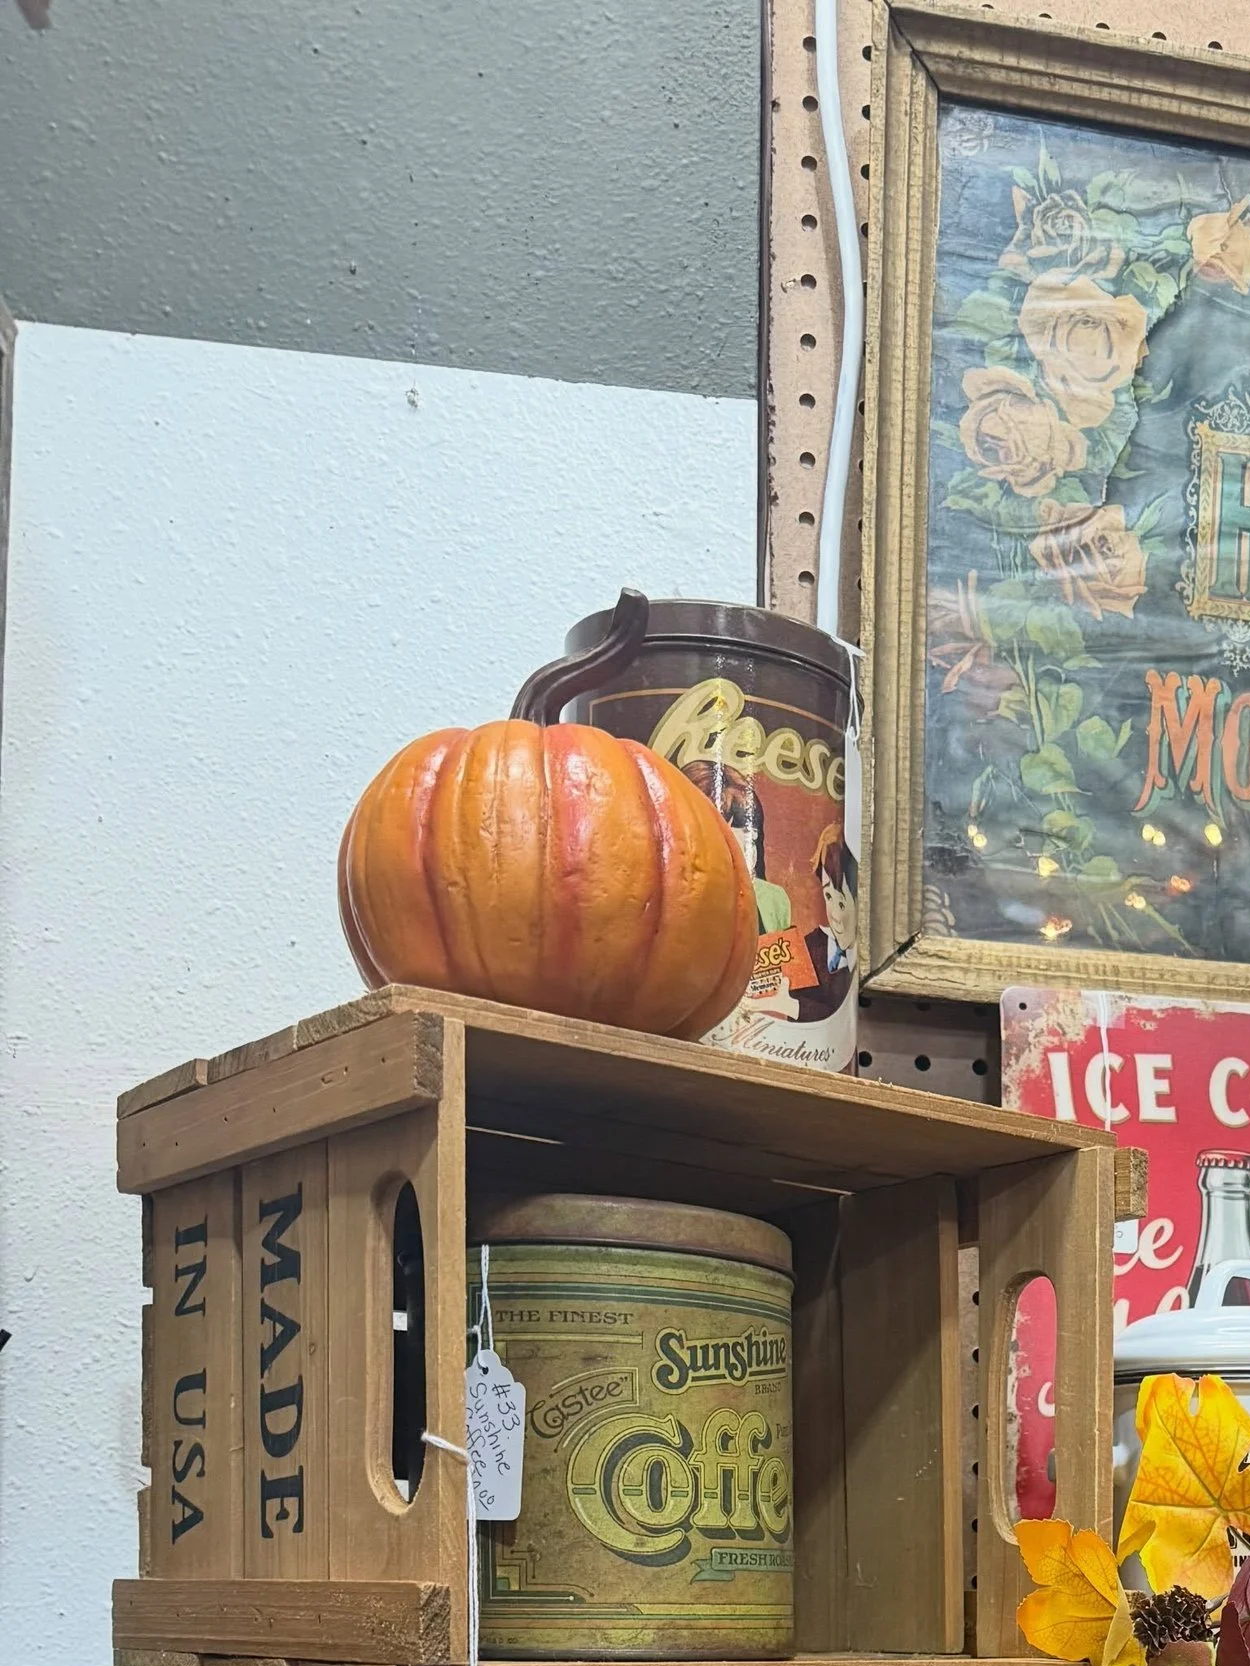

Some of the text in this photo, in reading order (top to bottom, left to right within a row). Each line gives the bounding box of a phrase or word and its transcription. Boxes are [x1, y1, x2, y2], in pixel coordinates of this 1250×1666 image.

[713, 1016, 834, 1062] Miniatures
[1046, 1050, 1177, 1124] ICE
[496, 1309, 634, 1326] THE FINEST
[171, 1214, 209, 1546] IN USA
[259, 1183, 304, 1539] MADE
[656, 1326, 788, 1390] Sunshine
[718, 1552, 768, 1567] FRESH
